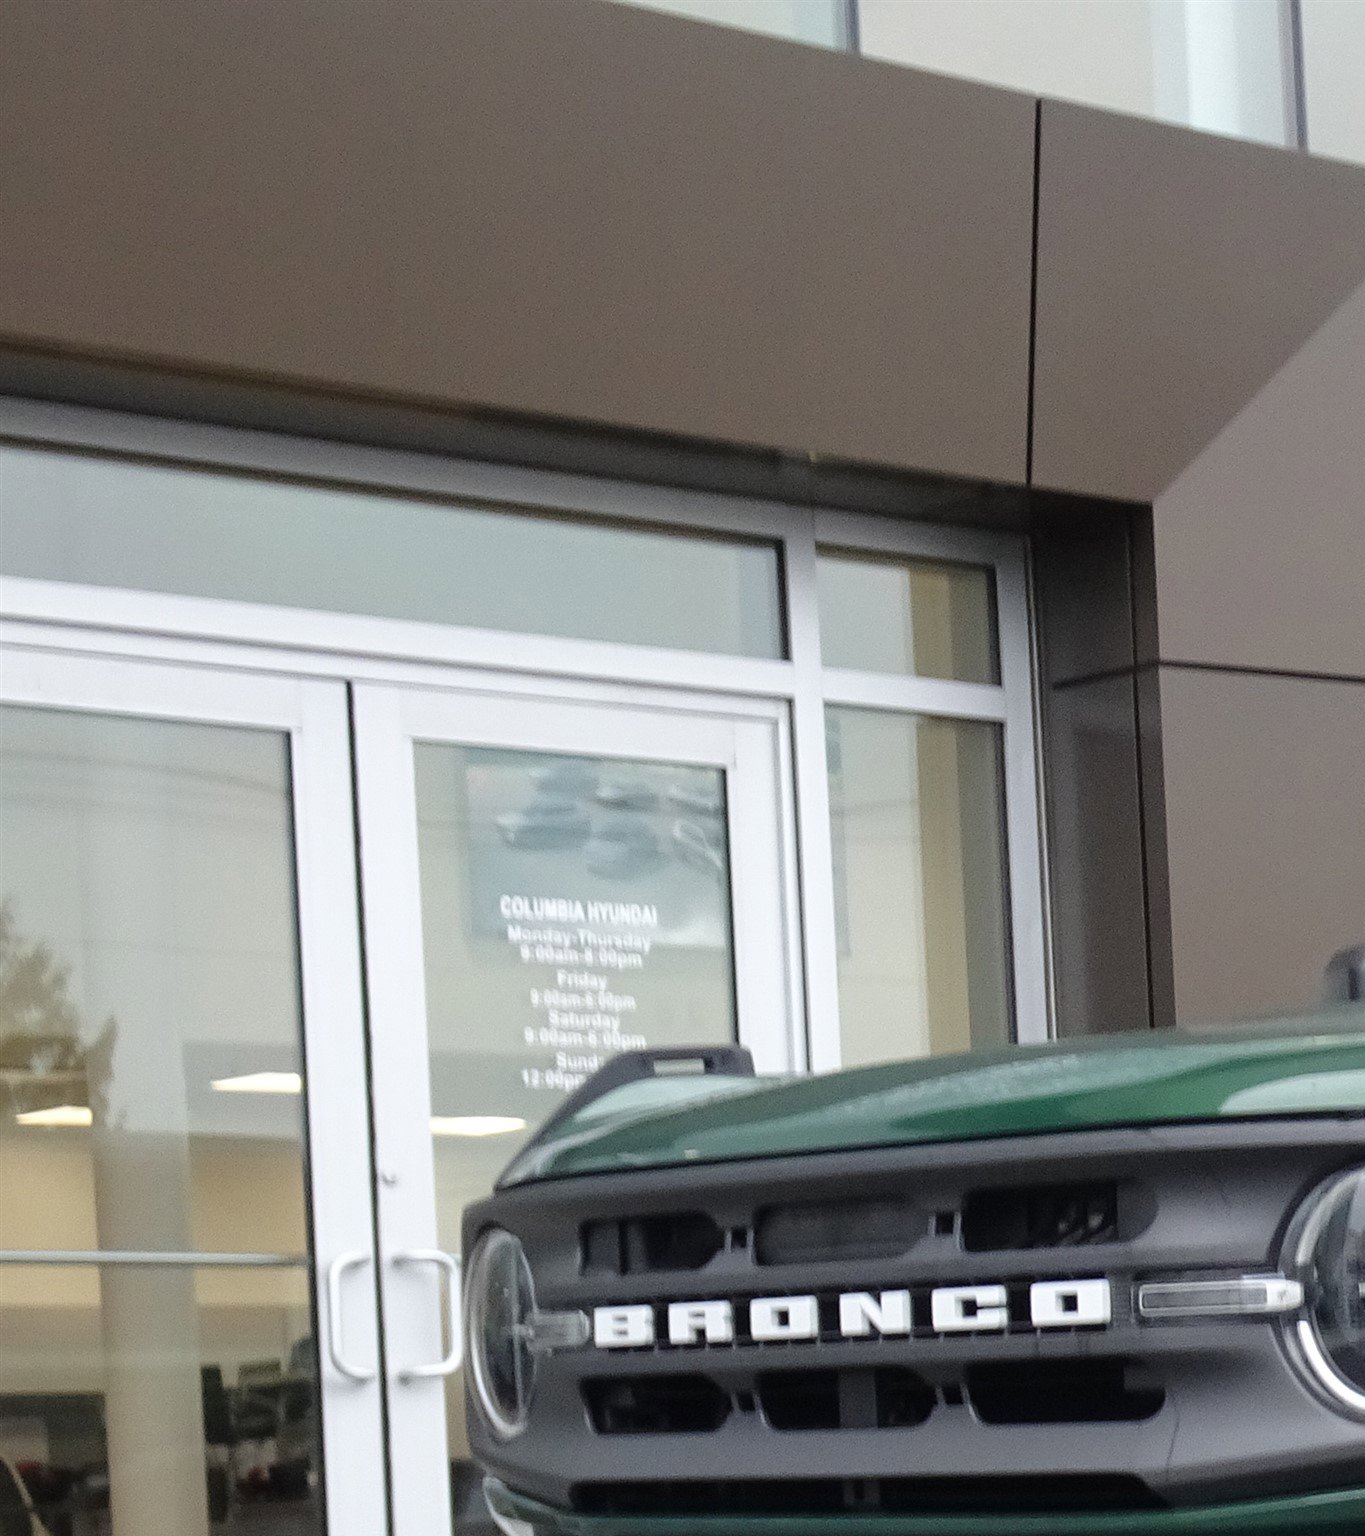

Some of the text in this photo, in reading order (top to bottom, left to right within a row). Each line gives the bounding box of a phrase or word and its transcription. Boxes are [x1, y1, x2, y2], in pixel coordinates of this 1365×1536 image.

[500, 894, 658, 927] COLUMBIA HYUNDAI
[557, 968, 608, 991] Friday
[549, 1009, 620, 1031] Saturday
[556, 1051, 604, 1073] Sund
[594, 1278, 1111, 1349] BRONCO
